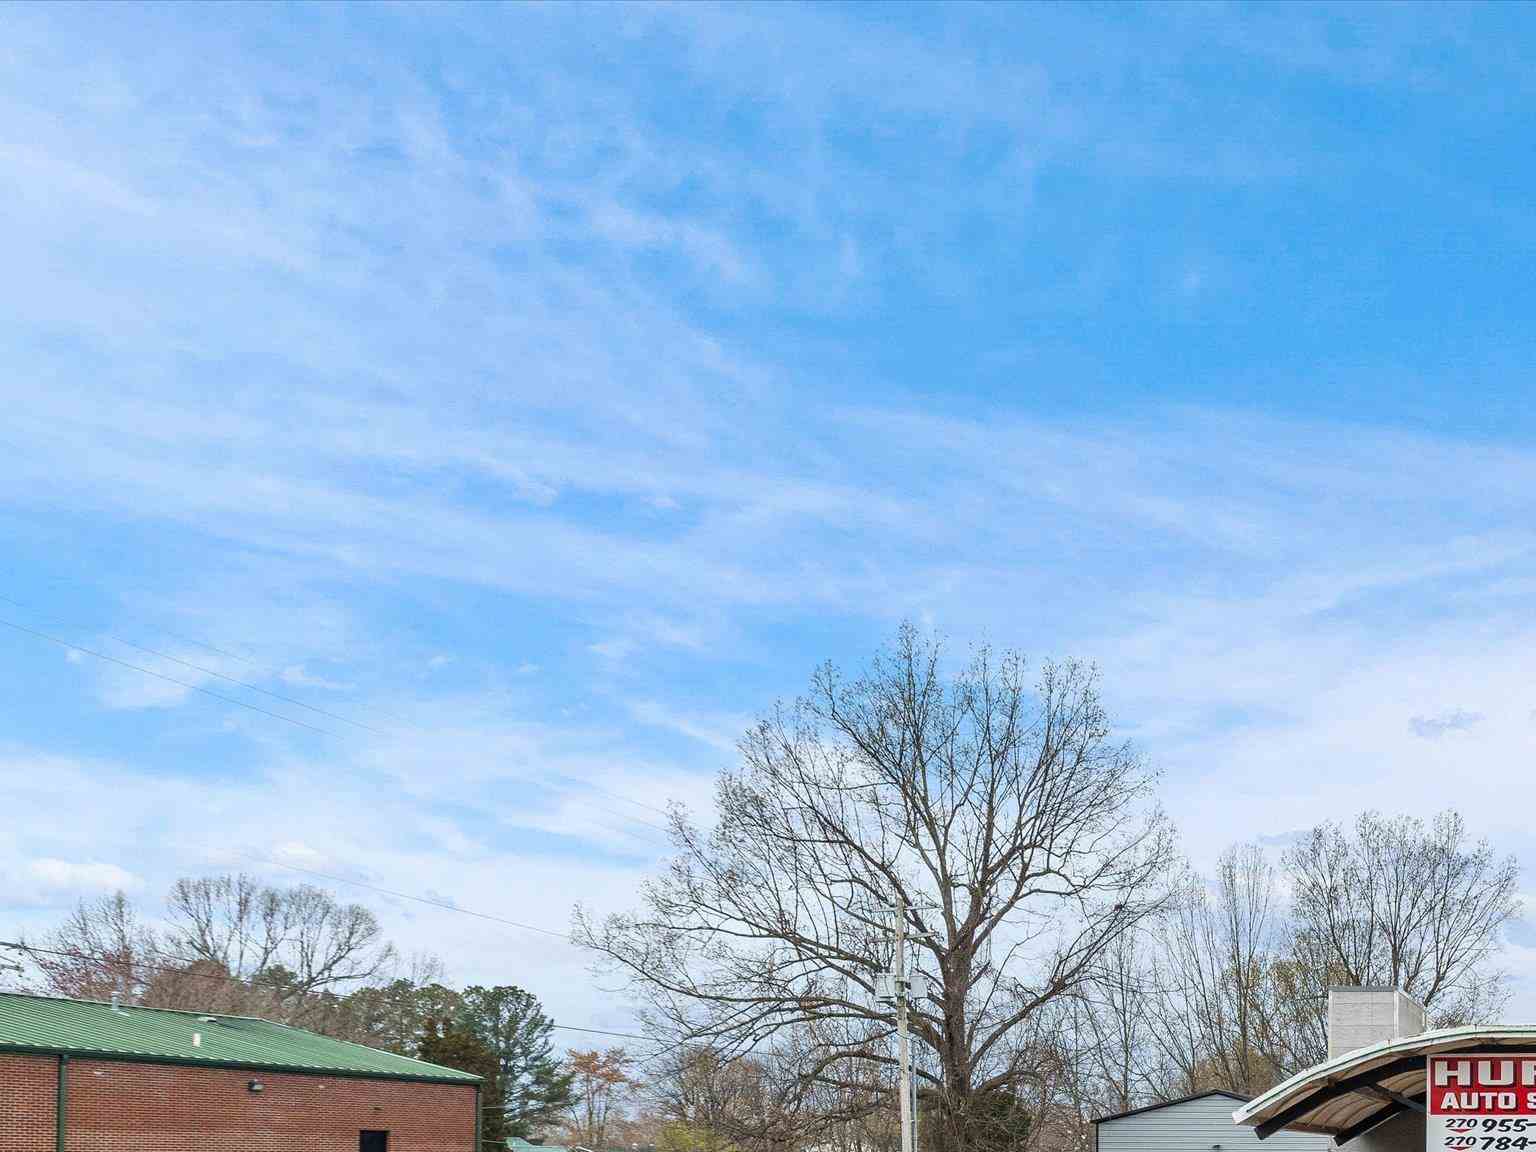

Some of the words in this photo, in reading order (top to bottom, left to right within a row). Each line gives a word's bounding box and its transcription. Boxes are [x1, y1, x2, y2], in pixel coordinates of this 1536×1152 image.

[1440, 1092, 1517, 1110] AUTO
[1444, 1118, 1478, 1128] 270
[1443, 1136, 1477, 1146] 270
